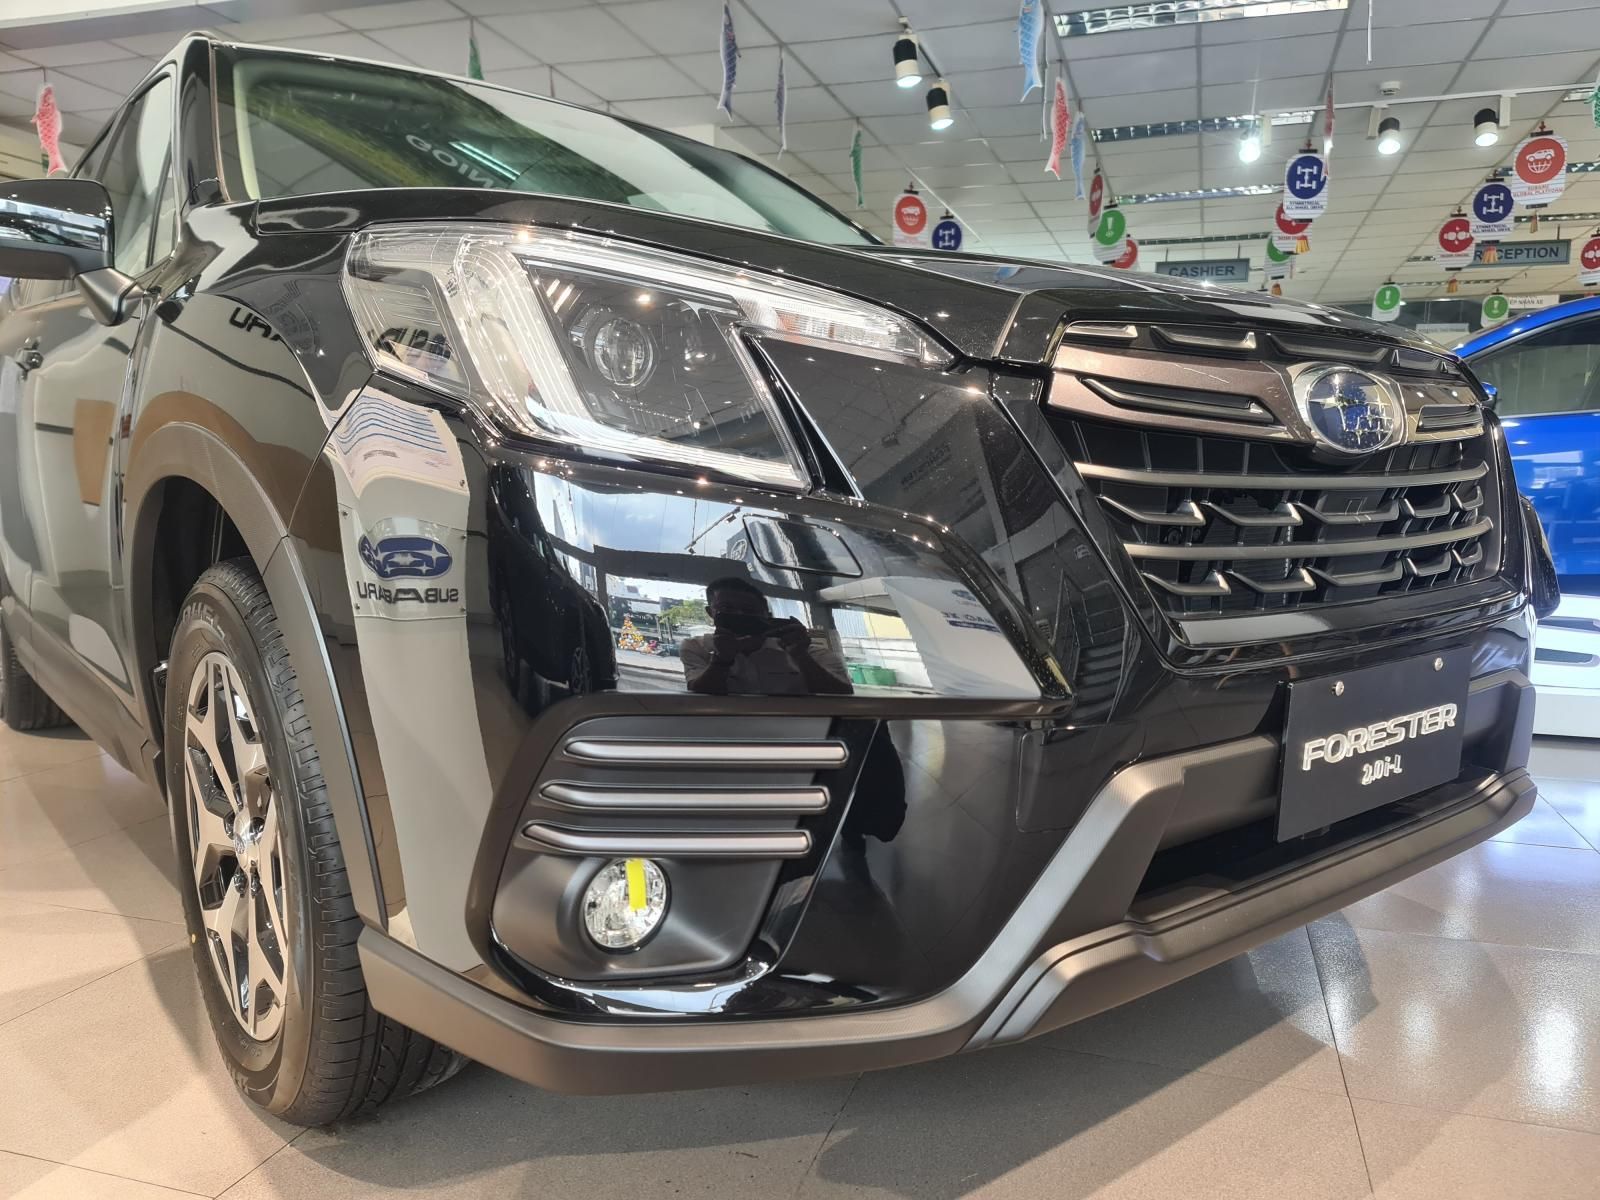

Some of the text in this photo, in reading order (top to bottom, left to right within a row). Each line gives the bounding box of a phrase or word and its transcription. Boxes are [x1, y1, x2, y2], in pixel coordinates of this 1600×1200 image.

[1474, 247, 1560, 261] RCEPTION
[1168, 265, 1235, 278] CASHIER
[1301, 702, 1459, 771] FORESTER
[1361, 753, 1404, 786] 2.0i-L
